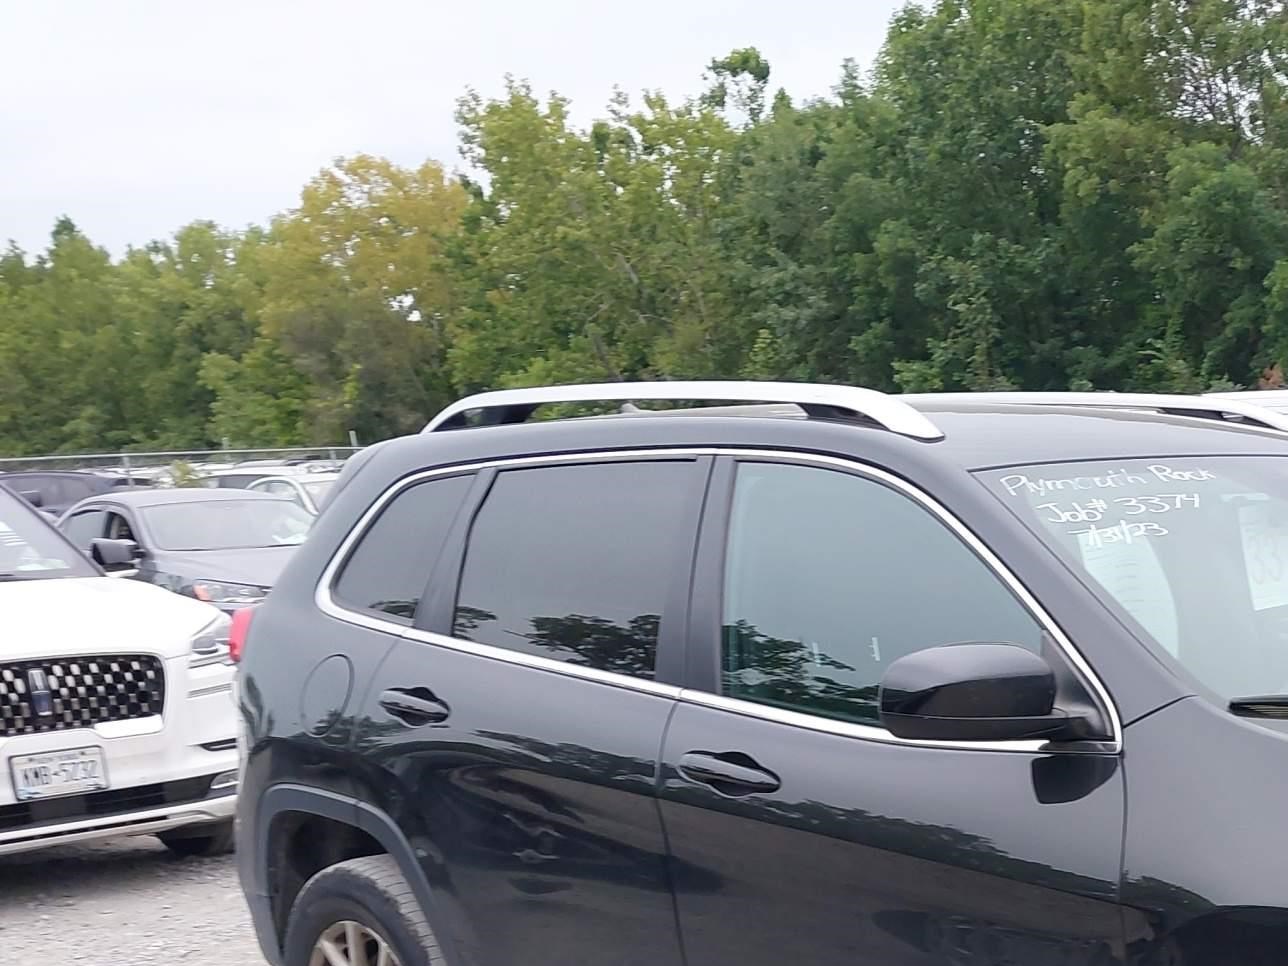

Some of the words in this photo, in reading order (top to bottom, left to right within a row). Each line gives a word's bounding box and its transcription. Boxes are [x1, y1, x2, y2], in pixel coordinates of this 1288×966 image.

[1000, 468, 1148, 497] Plymouth
[1146, 464, 1217, 483] Rock
[1035, 498, 1108, 523] Job#
[1113, 493, 1200, 515] 3374
